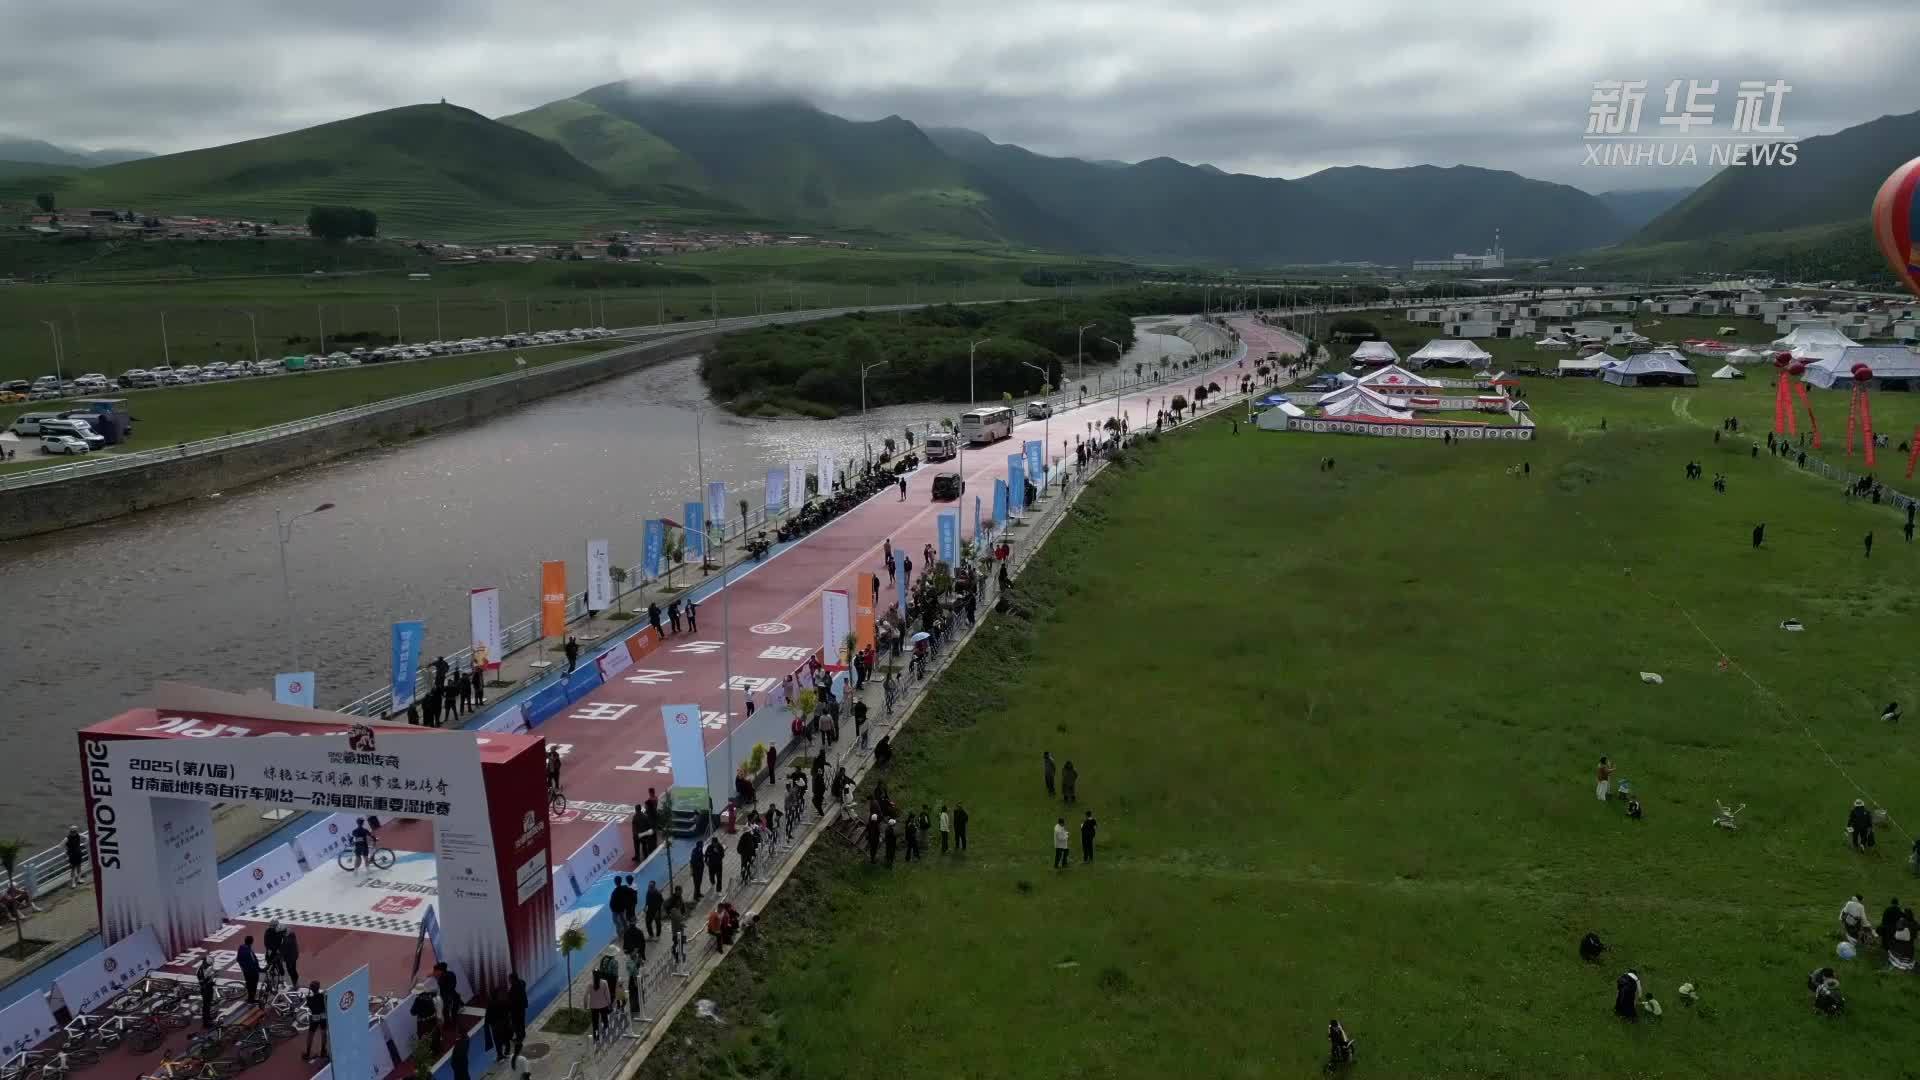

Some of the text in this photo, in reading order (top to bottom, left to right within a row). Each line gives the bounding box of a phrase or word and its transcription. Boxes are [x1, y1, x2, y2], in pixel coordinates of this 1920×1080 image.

[343, 752, 400, 769] 藏地传奇
[88, 740, 120, 869] SINO EPIC
